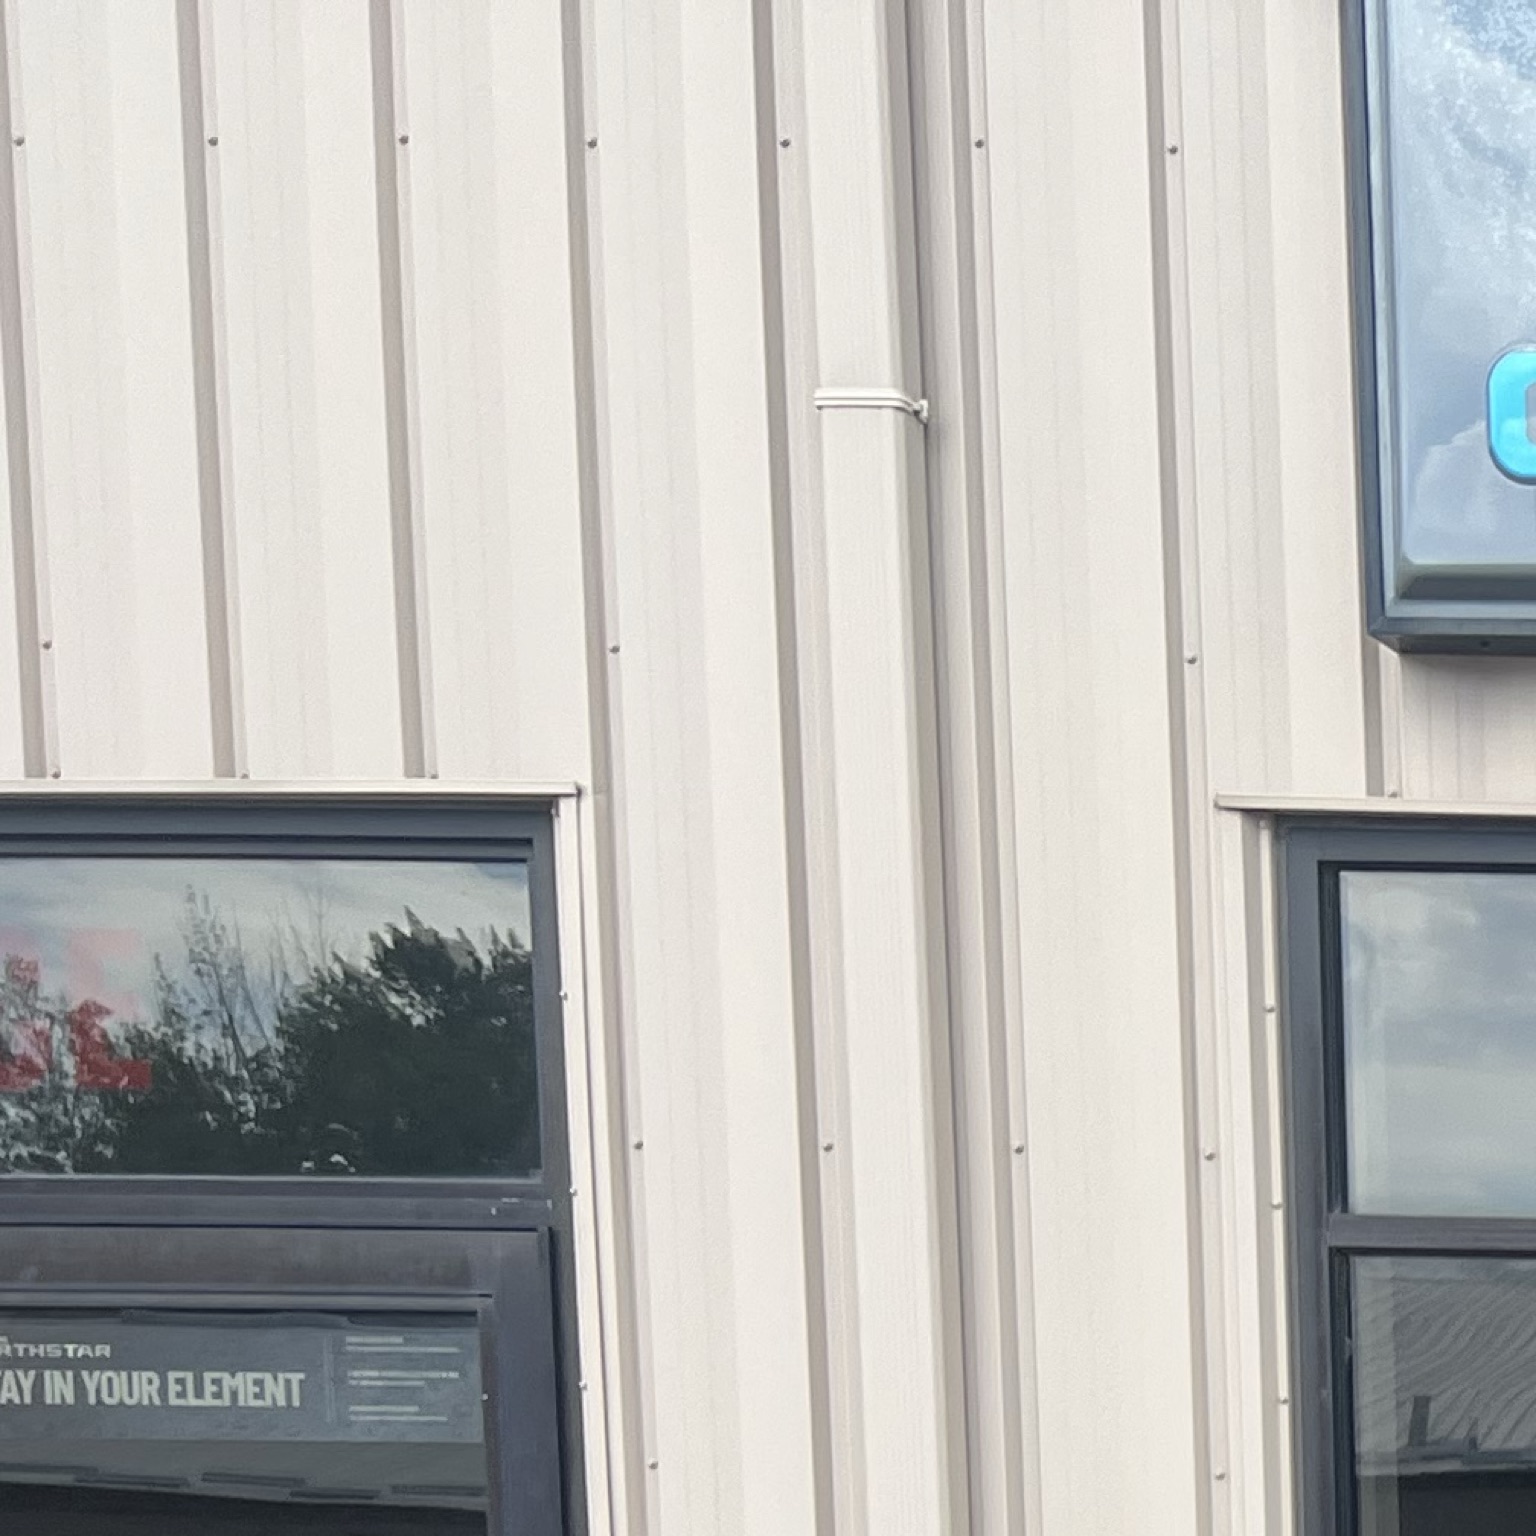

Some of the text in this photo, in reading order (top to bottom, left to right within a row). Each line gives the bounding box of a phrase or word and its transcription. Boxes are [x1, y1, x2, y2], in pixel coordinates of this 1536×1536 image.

[0, 1368, 305, 1407] AY IN YOUR ELEMENT
